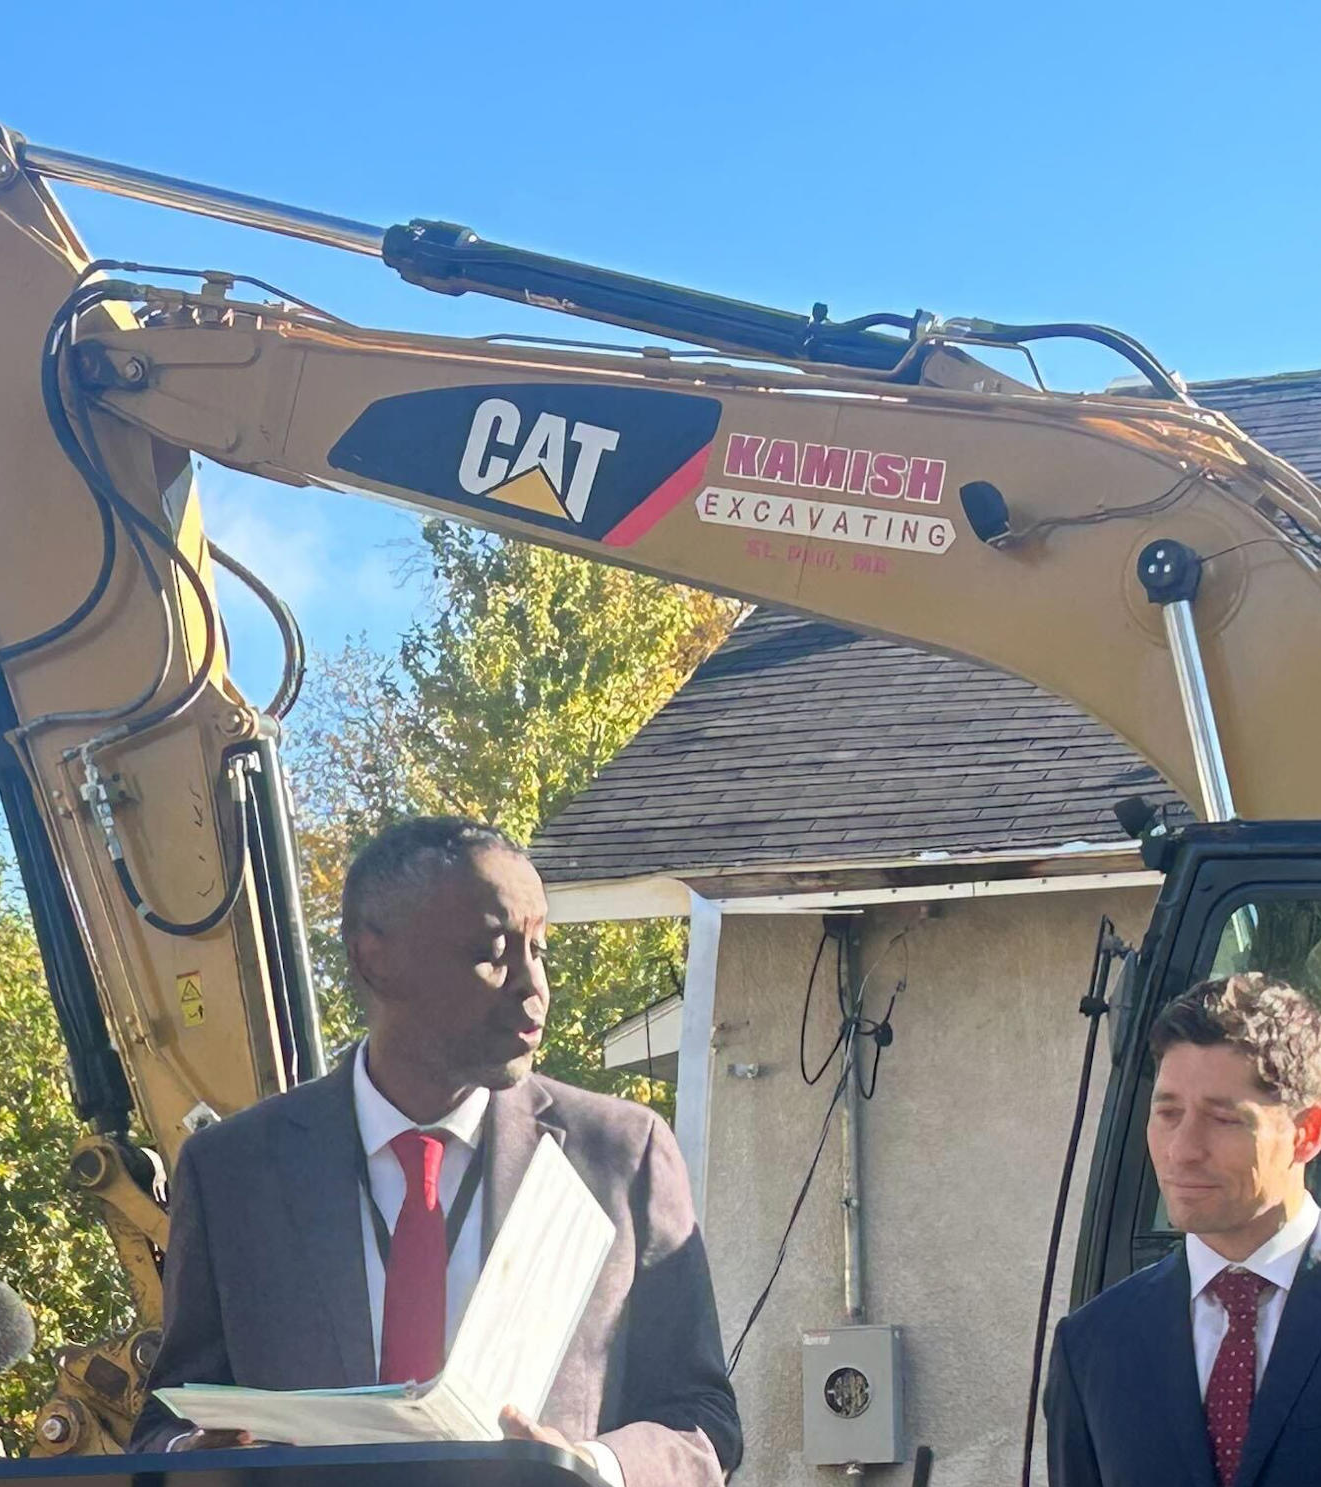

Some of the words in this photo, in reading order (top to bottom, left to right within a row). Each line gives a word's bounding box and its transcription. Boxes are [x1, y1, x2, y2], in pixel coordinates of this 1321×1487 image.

[458, 397, 620, 523] CAT
[723, 433, 947, 504] KAMISH
[704, 492, 947, 547] EXCAVATING
